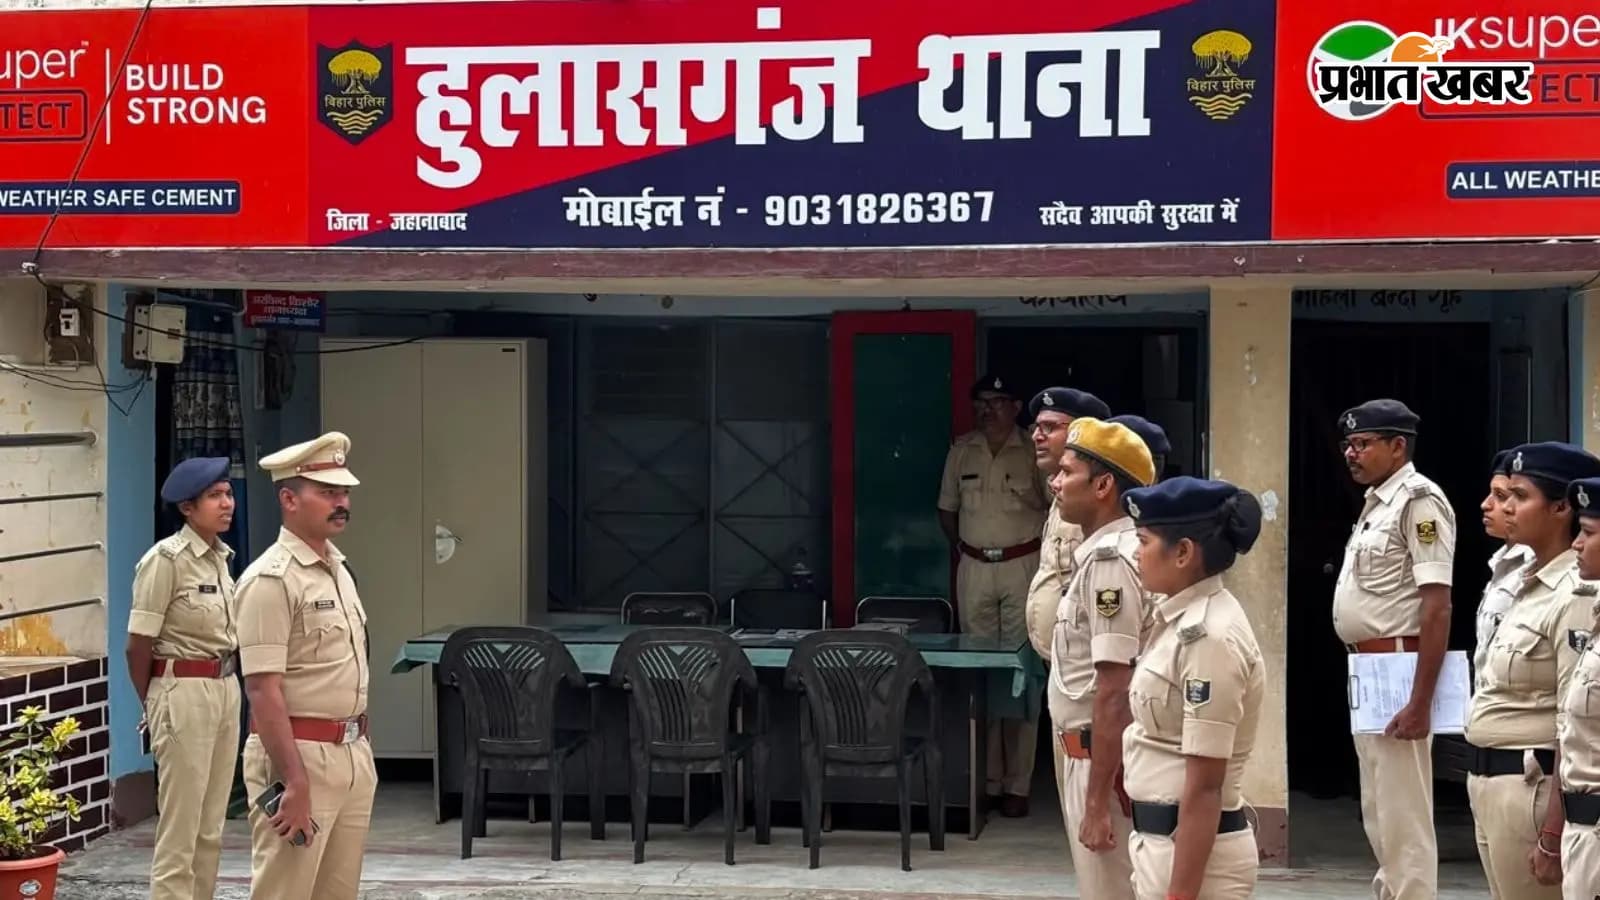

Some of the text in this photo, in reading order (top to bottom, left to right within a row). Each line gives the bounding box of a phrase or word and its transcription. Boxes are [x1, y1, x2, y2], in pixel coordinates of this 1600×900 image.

[126, 64, 224, 91] BUILD
[1222, 78, 1256, 94] पुलिस
[1530, 73, 1600, 103] ECT
[127, 97, 267, 125] STRONG
[356, 95, 386, 109] पुलिस
[405, 7, 1161, 189] हुलासगंज थाना
[1451, 170, 1600, 190] ALL WEATHE
[93, 189, 146, 207] SAFE
[152, 188, 237, 207] CEMENT
[562, 187, 684, 231] मोबाईल
[695, 186, 725, 227] नं
[765, 191, 995, 226] 9031826367
[326, 209, 369, 232] जिला
[390, 212, 468, 232] जहानाबाद
[1039, 198, 1240, 231] सदैव आपकी सुरक्षा में
